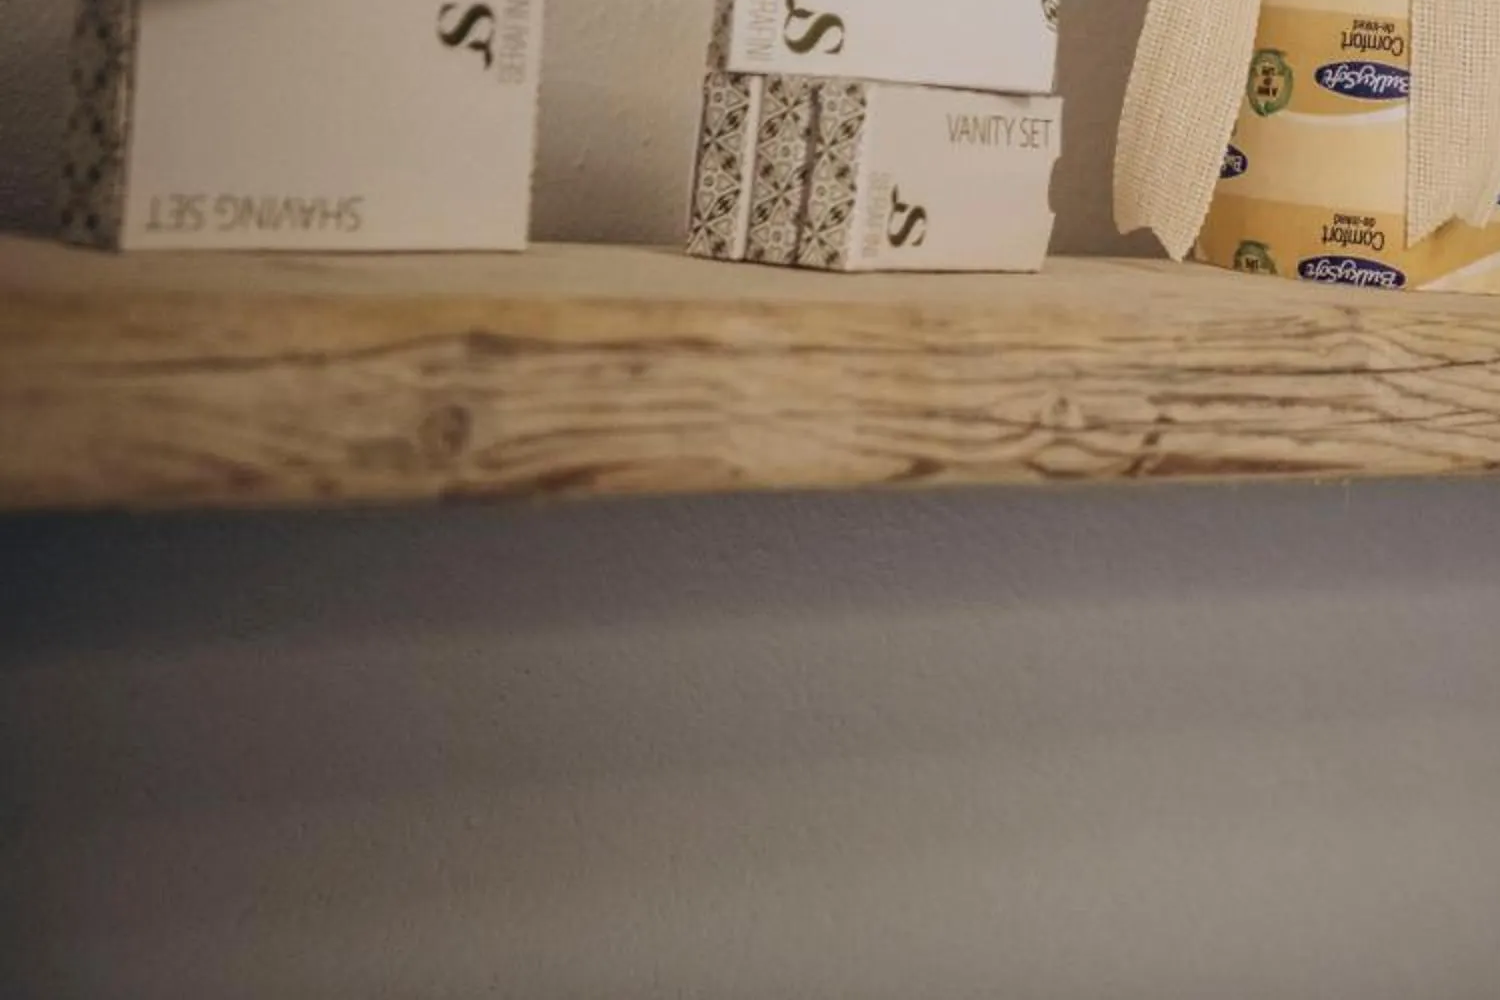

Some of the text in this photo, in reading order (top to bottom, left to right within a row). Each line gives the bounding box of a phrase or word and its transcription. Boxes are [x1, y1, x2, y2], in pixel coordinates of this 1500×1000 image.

[1341, 31, 1404, 57] Comfort
[1321, 63, 1409, 95] BulkySoft
[946, 113, 1053, 149] VANITY SET
[145, 193, 364, 231] SHAVING SET
[1322, 225, 1385, 251] Comfort
[1305, 259, 1397, 289] BulkySoft
